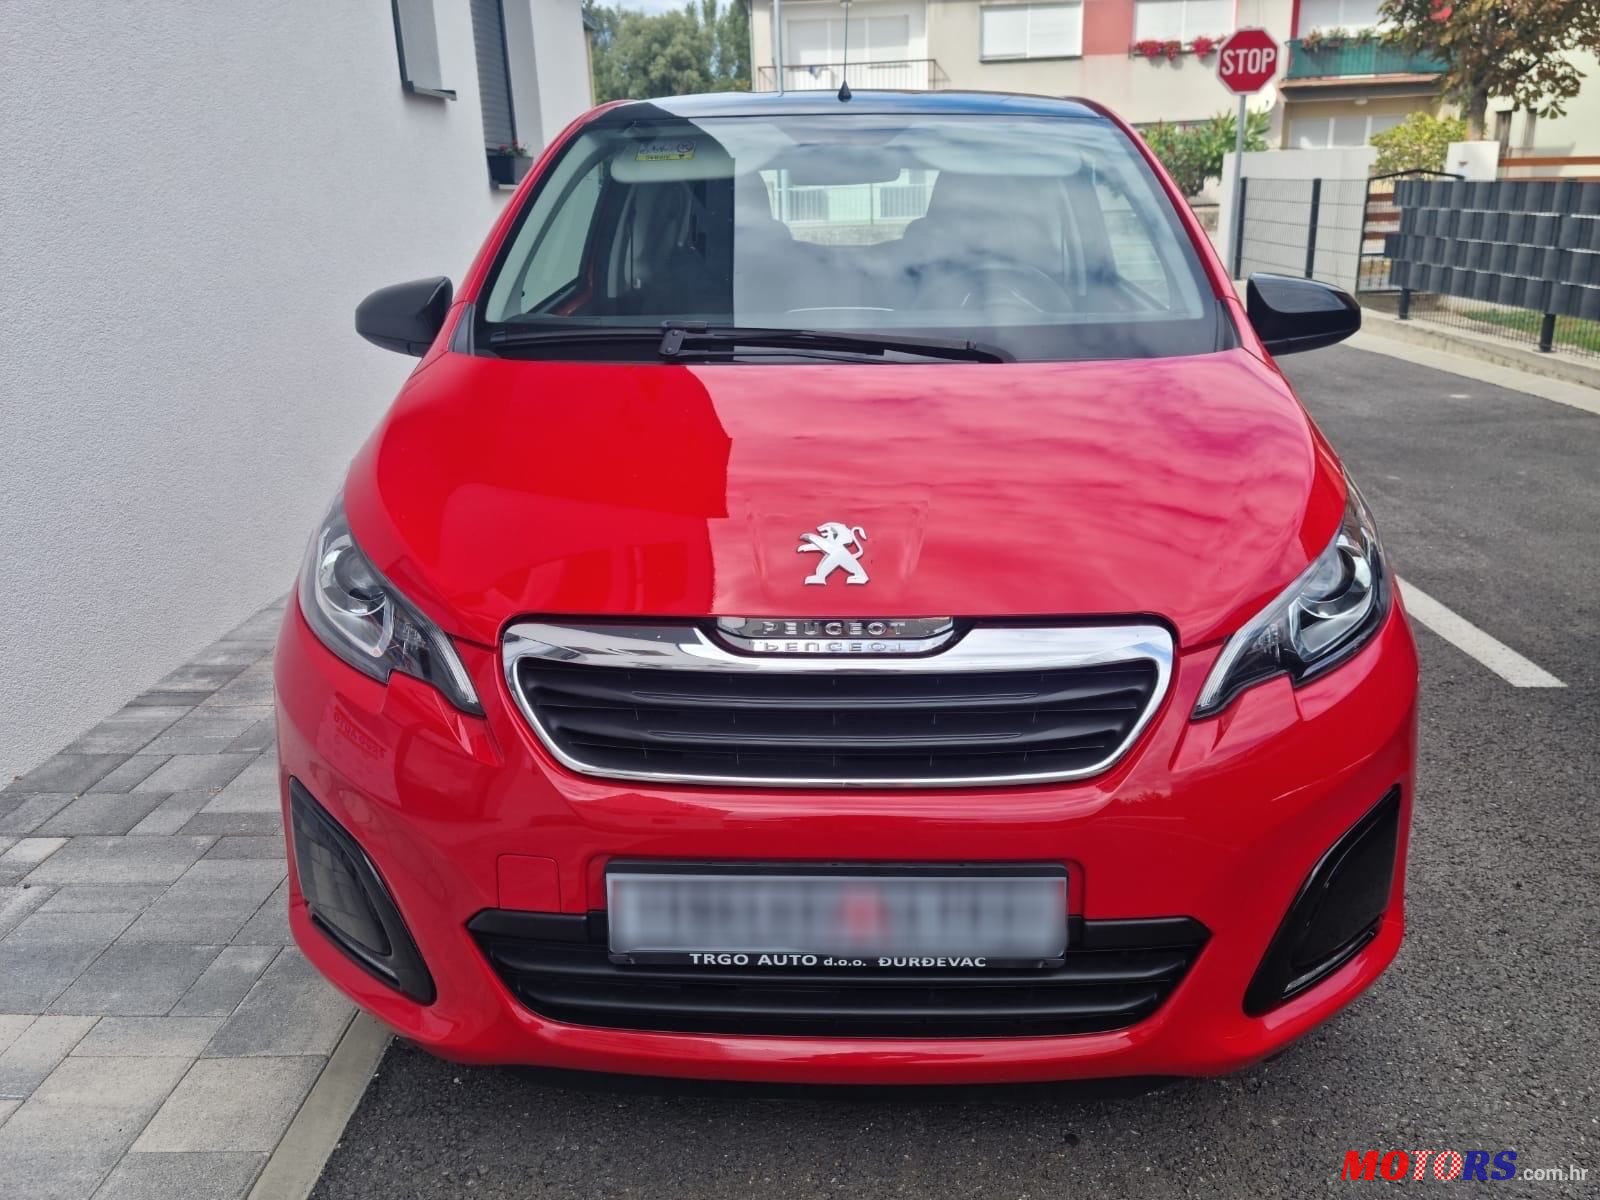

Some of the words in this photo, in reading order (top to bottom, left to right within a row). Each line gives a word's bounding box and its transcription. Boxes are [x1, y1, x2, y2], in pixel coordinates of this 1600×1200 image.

[1221, 48, 1275, 75] STOP
[761, 621, 906, 636] PEUGEOT
[689, 953, 749, 966] TRGO
[757, 954, 818, 966] AUTO
[823, 957, 867, 967] d.o.o.
[878, 956, 987, 968] ĐURĐEVAC
